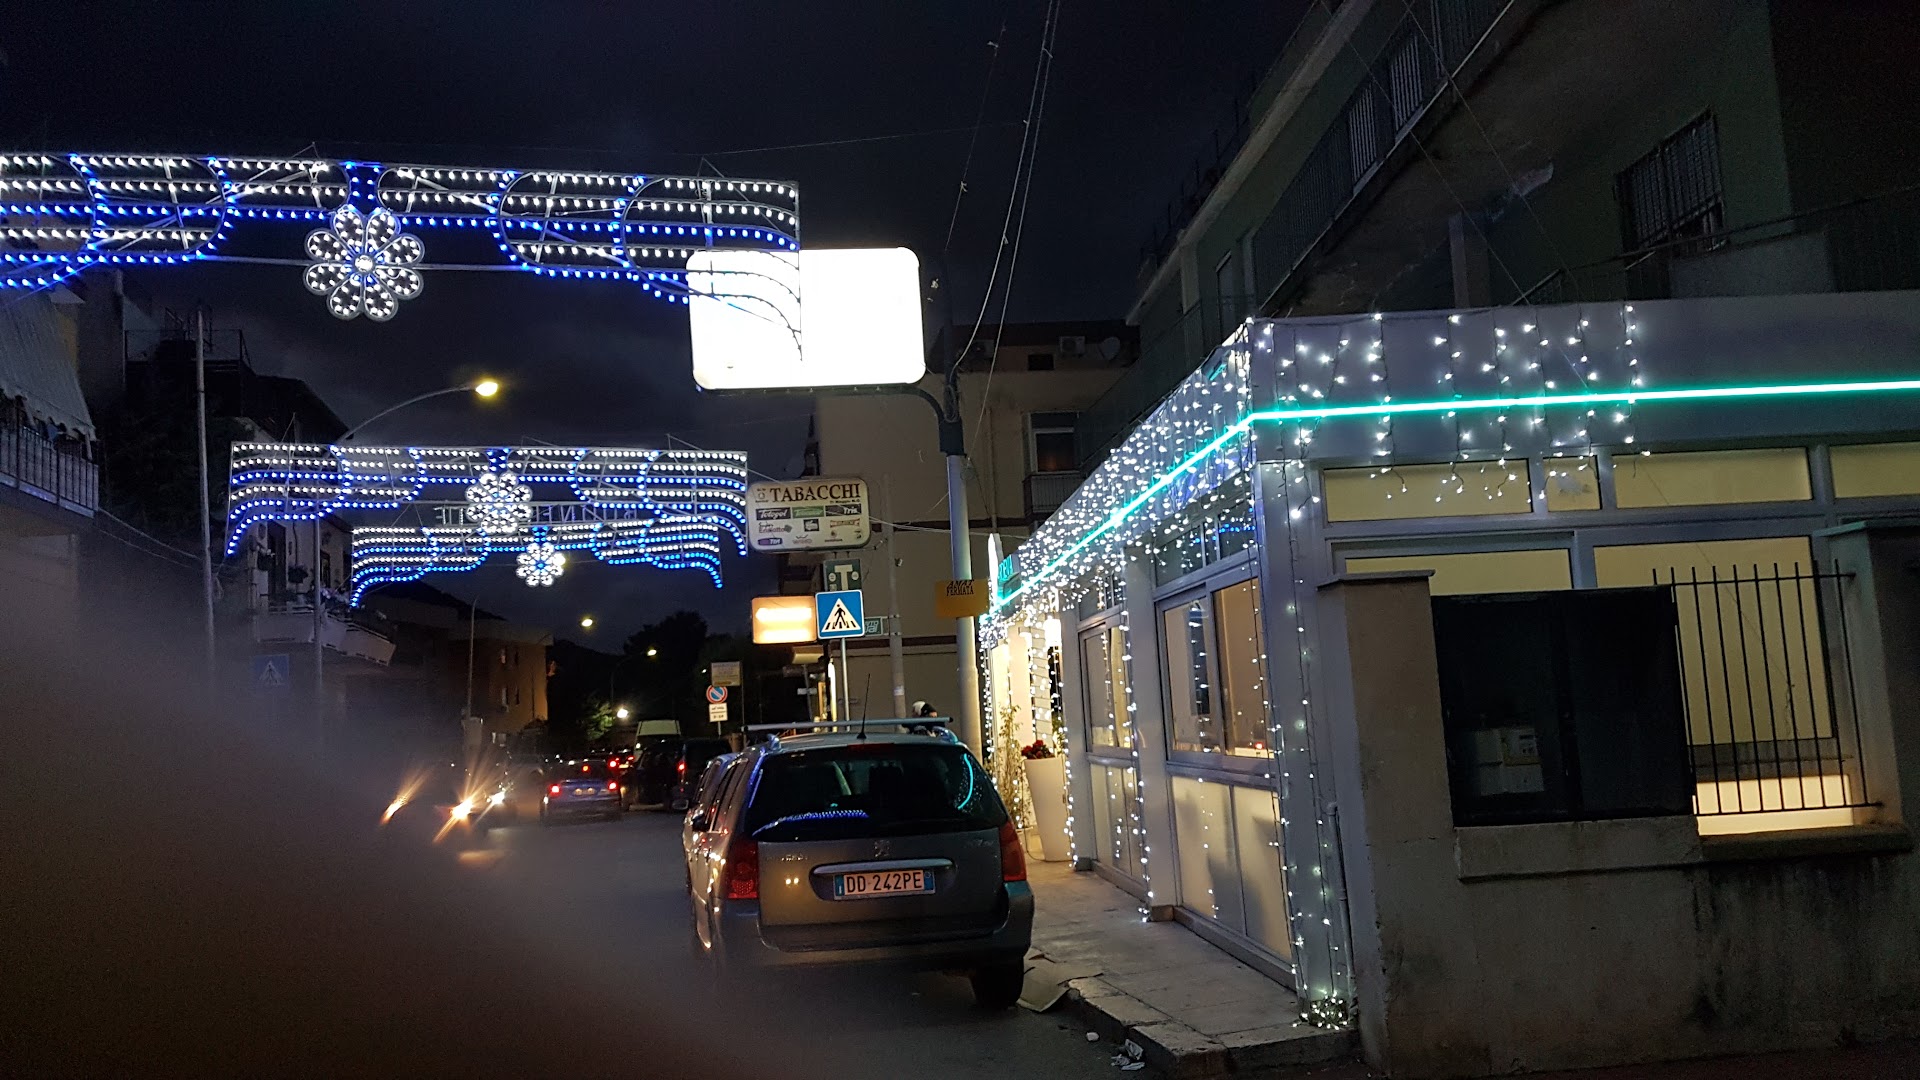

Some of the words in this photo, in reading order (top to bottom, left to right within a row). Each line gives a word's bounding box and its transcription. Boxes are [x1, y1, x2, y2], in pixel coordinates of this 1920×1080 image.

[769, 483, 861, 502] TABACCHI
[759, 509, 788, 520] Totogol
[846, 875, 866, 894] DD
[872, 871, 923, 891] 242PE
